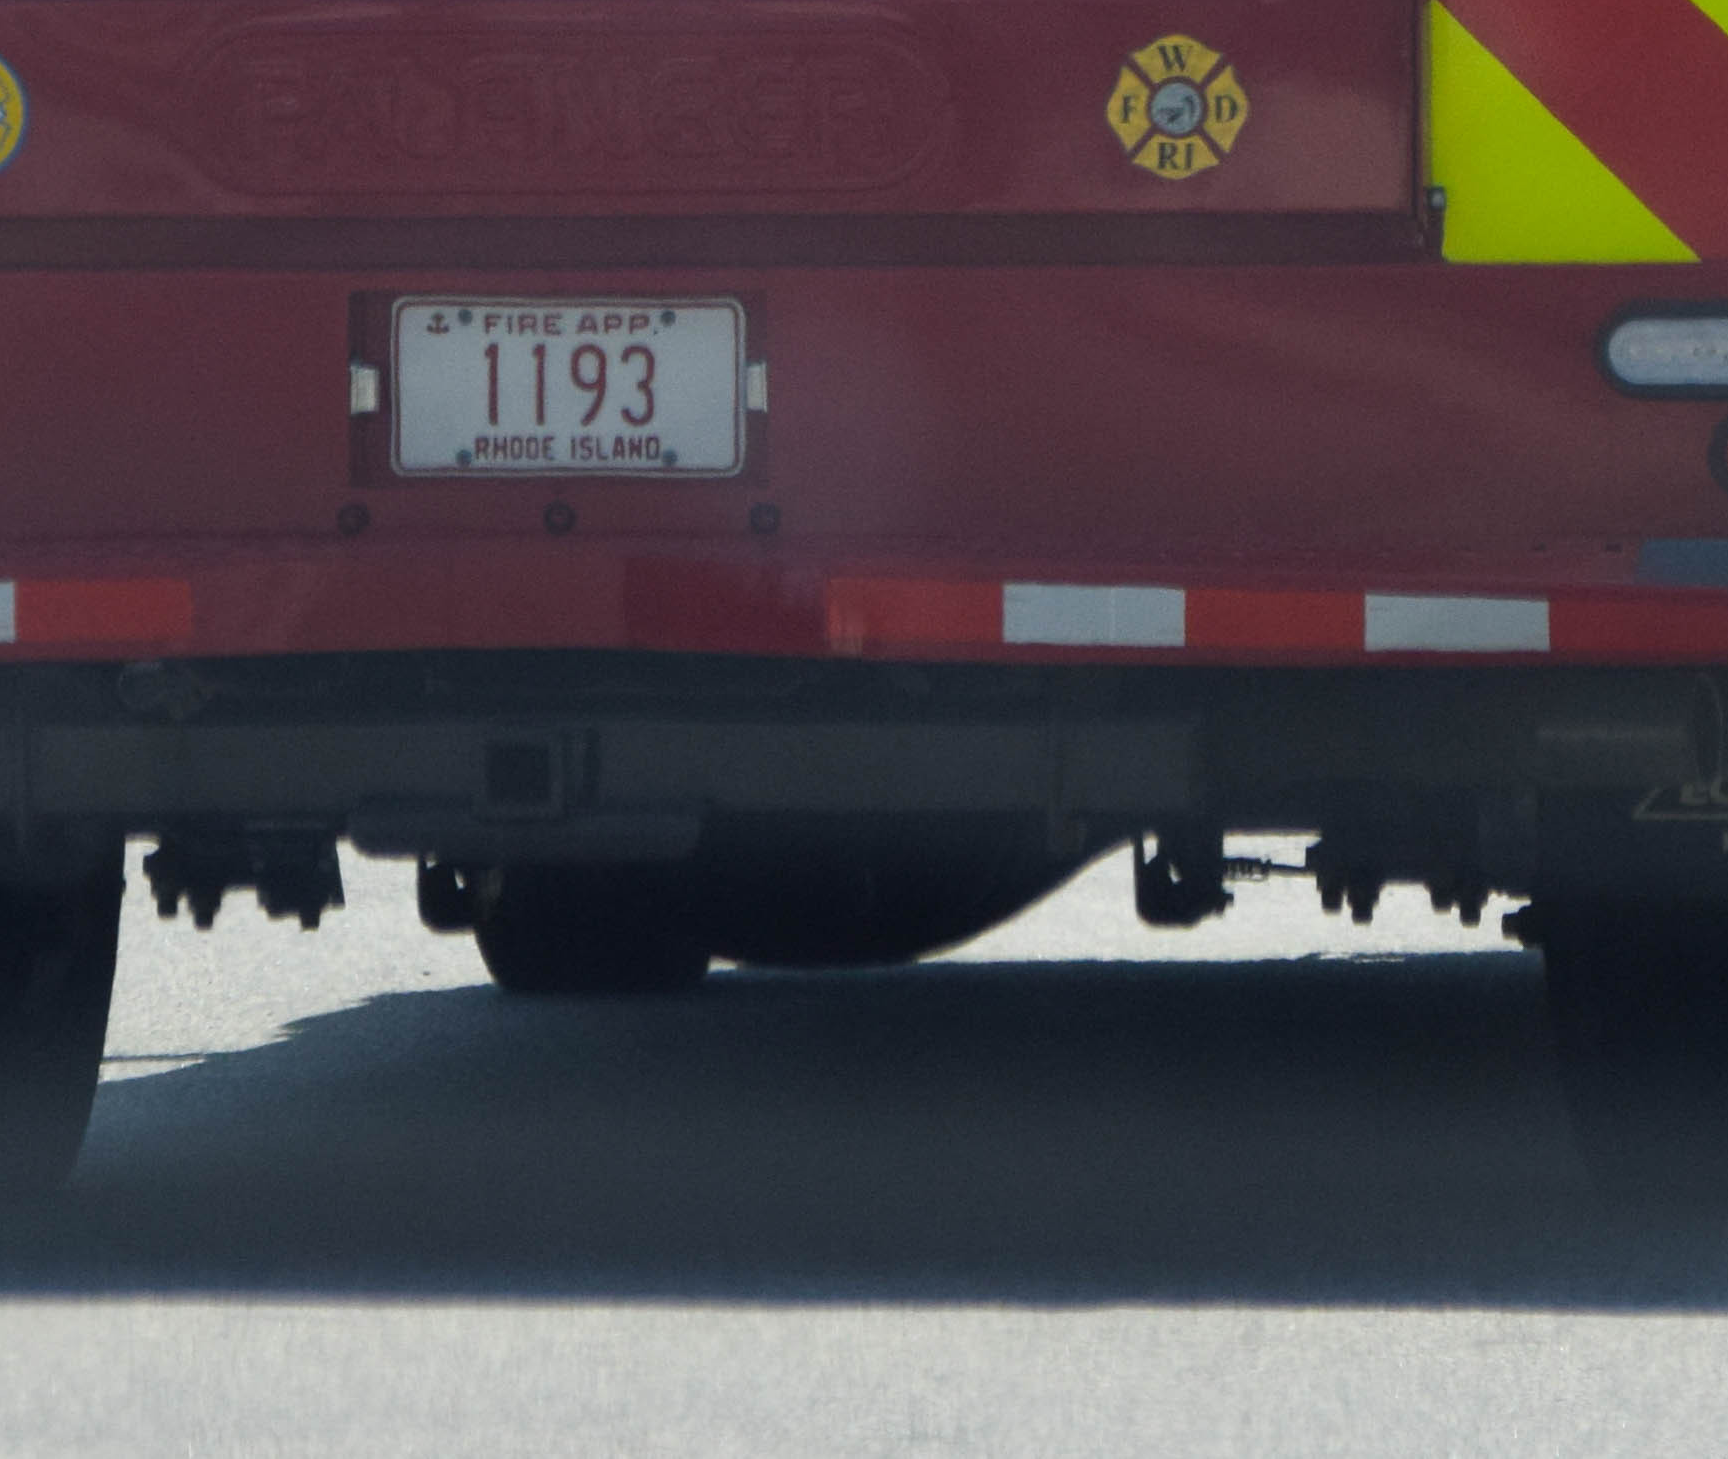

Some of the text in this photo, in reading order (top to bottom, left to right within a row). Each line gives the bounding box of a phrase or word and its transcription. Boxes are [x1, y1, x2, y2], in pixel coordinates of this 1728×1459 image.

[1158, 45, 1193, 72] W
[1120, 94, 1238, 124] F D
[1158, 142, 1194, 170] RI
[484, 313, 562, 335] FIRE
[484, 343, 656, 427] 1193
[474, 435, 661, 461] RHODE ISLAND
